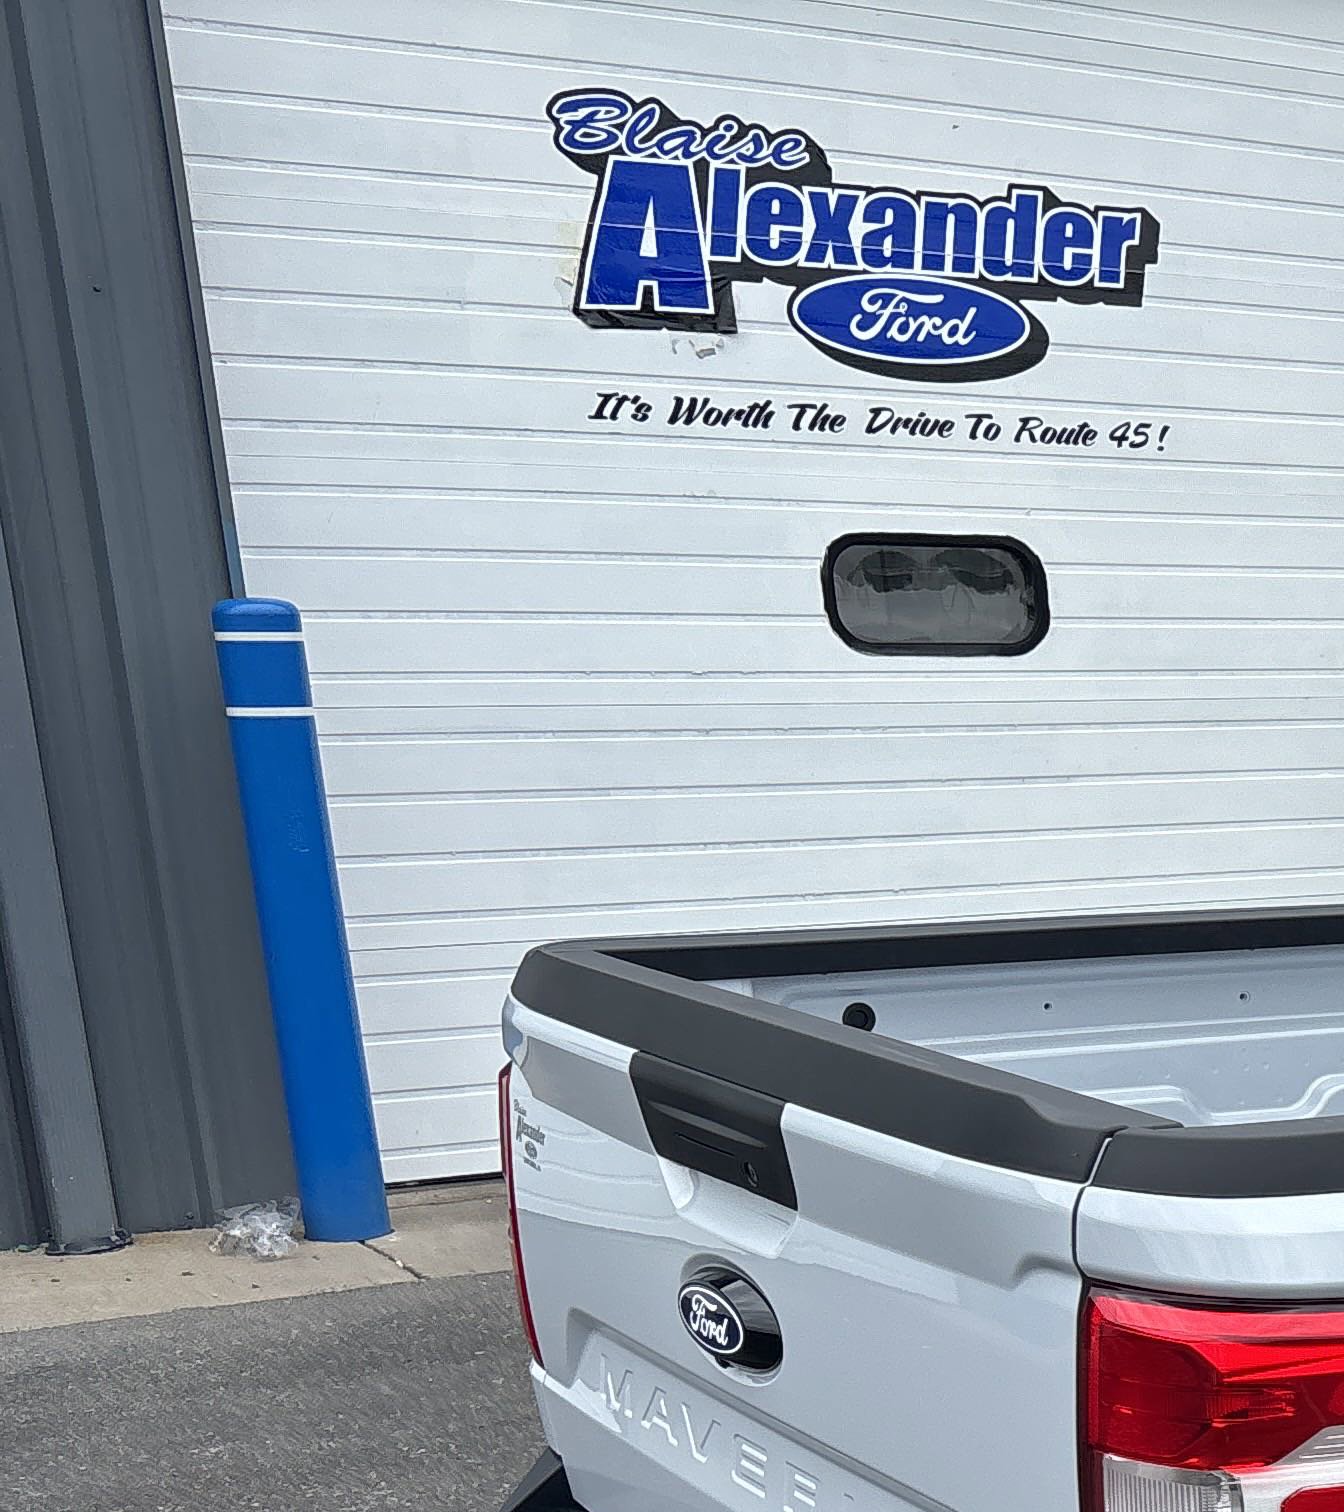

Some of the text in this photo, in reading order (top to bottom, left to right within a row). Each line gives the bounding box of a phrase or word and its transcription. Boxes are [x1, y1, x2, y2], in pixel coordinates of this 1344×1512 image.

[552, 93, 811, 170] Blaise
[578, 153, 1147, 315] Alexander
[849, 286, 977, 348] Ford
[587, 392, 653, 421] It's
[667, 396, 776, 429] Worth
[787, 403, 847, 433] The
[864, 407, 956, 438] Drive
[965, 413, 1001, 441] To
[1013, 417, 1099, 446] Route
[689, 1293, 729, 1347] Ford
